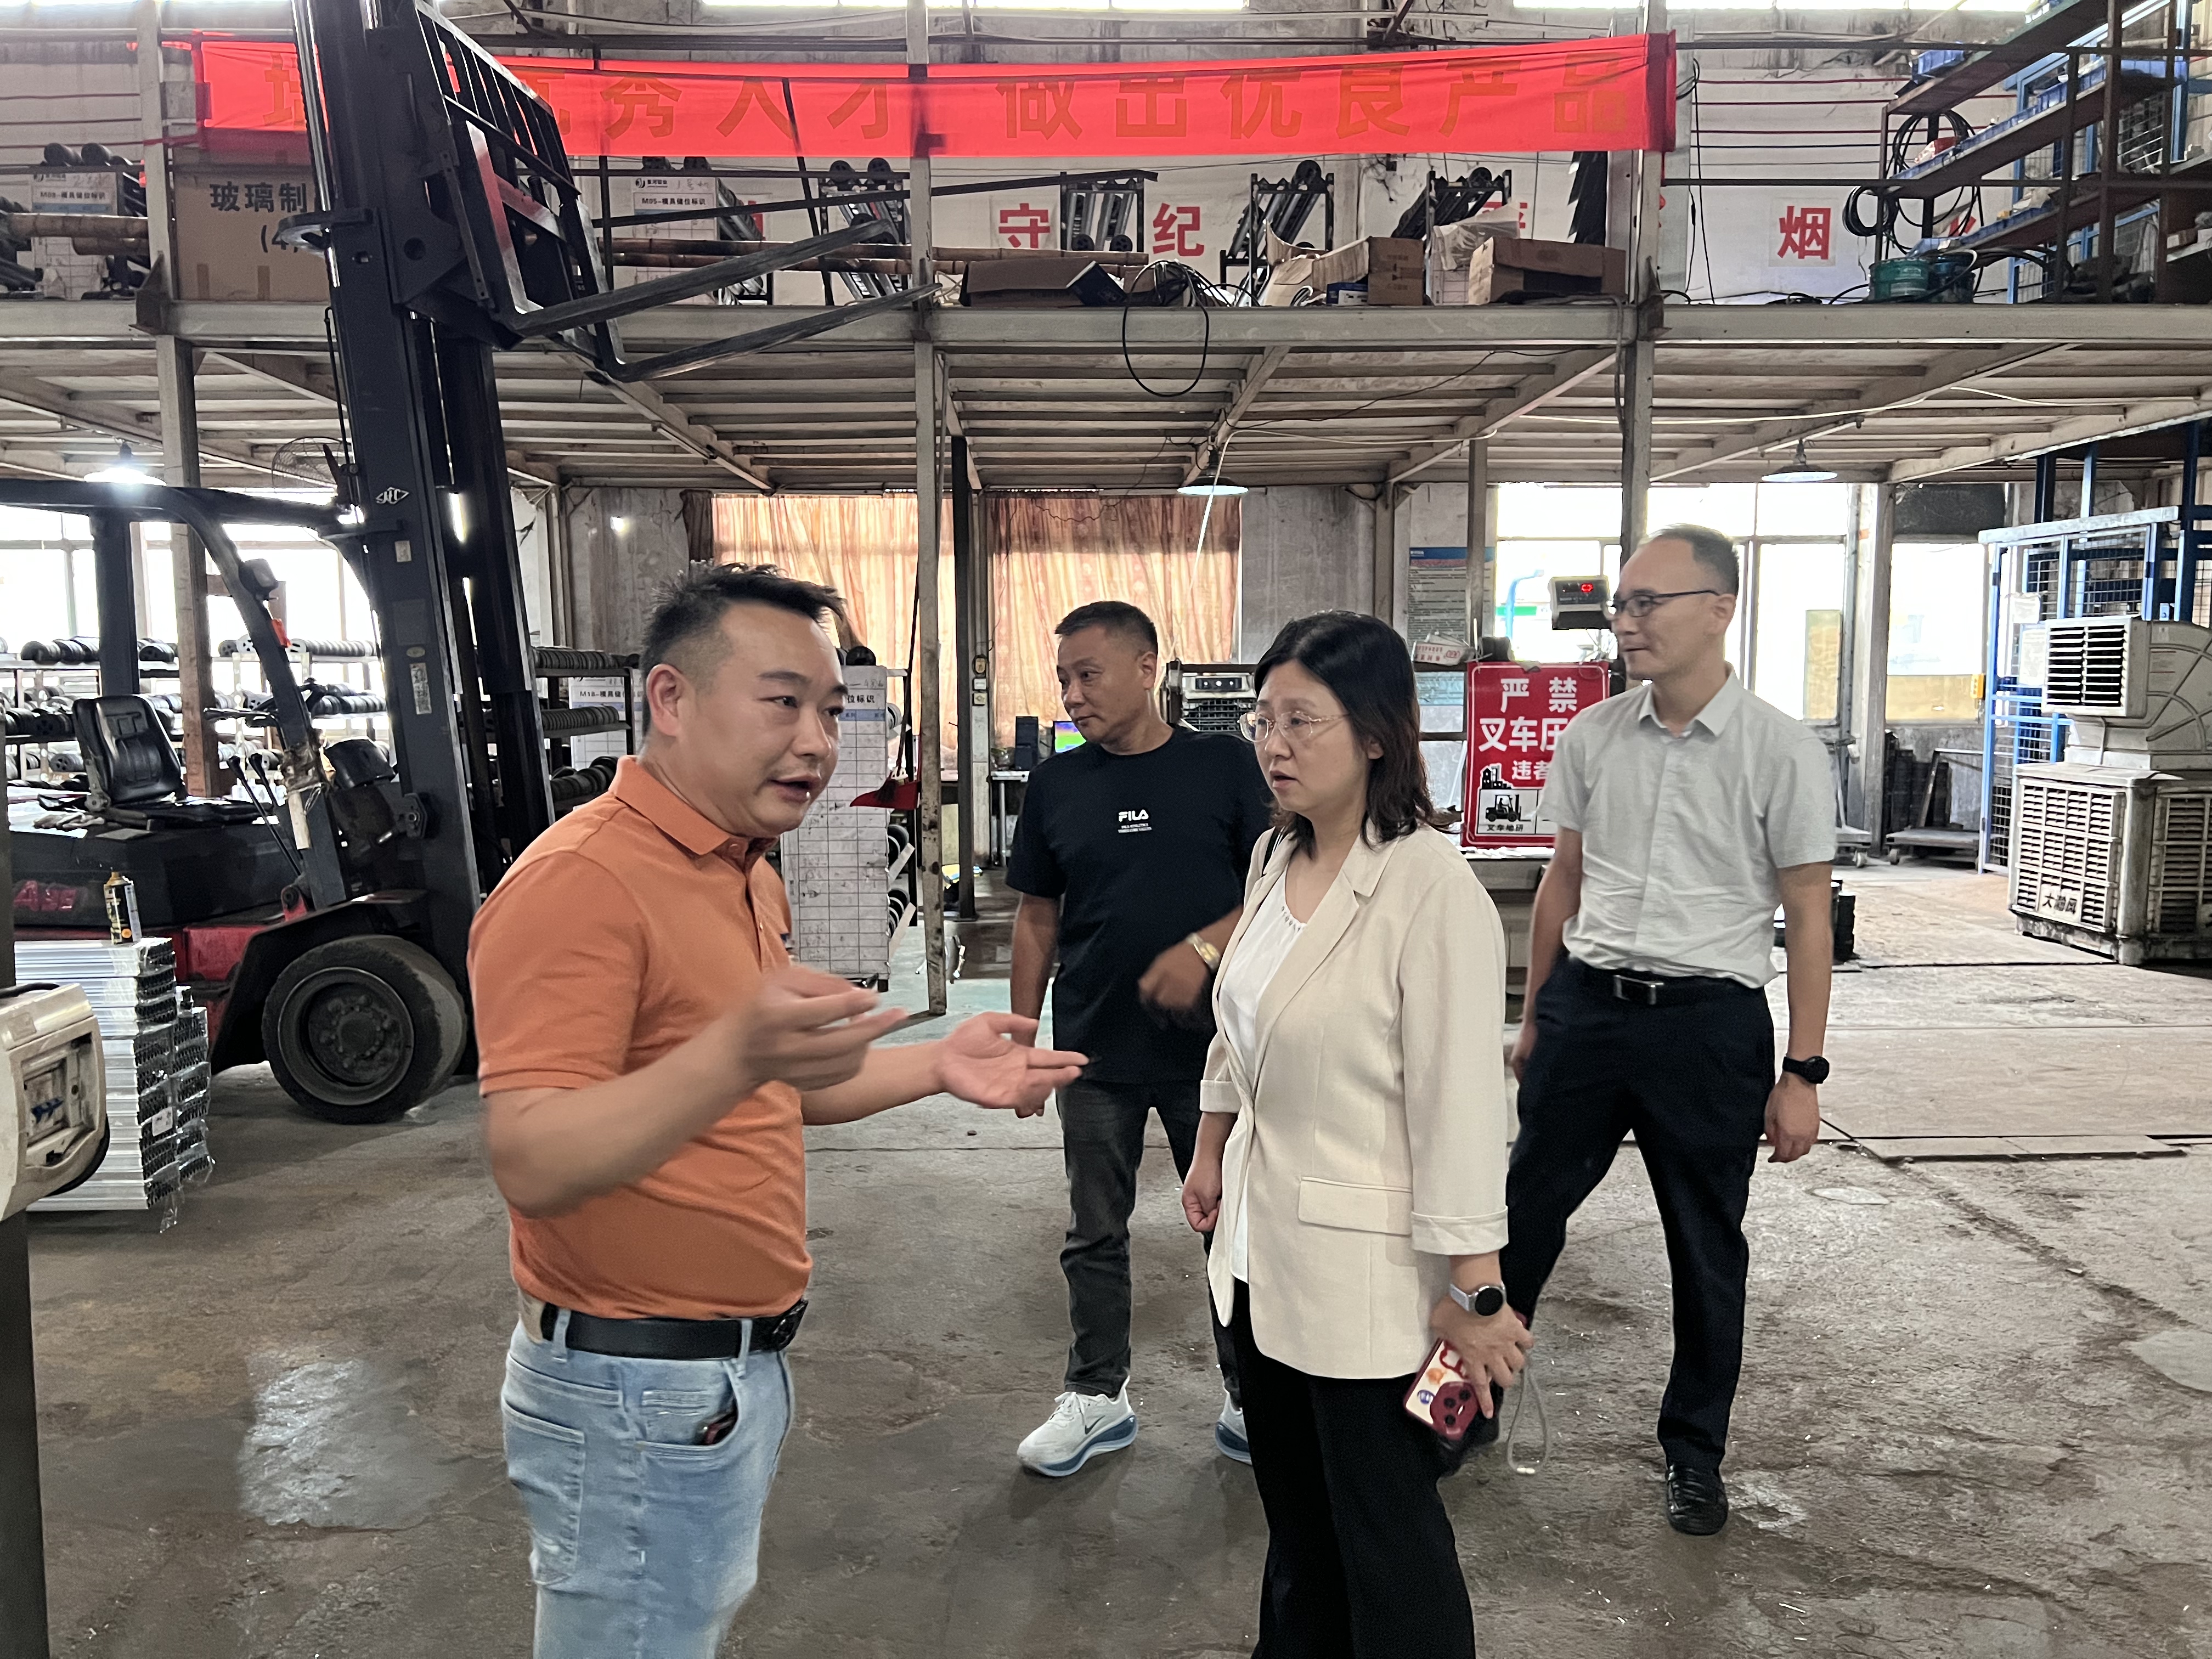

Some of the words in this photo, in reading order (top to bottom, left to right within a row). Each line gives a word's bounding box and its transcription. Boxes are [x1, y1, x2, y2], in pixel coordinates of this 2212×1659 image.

[1777, 205, 1831, 260] 烟
[1500, 677, 1577, 713] 严禁
[1119, 809, 1149, 822] FILA
